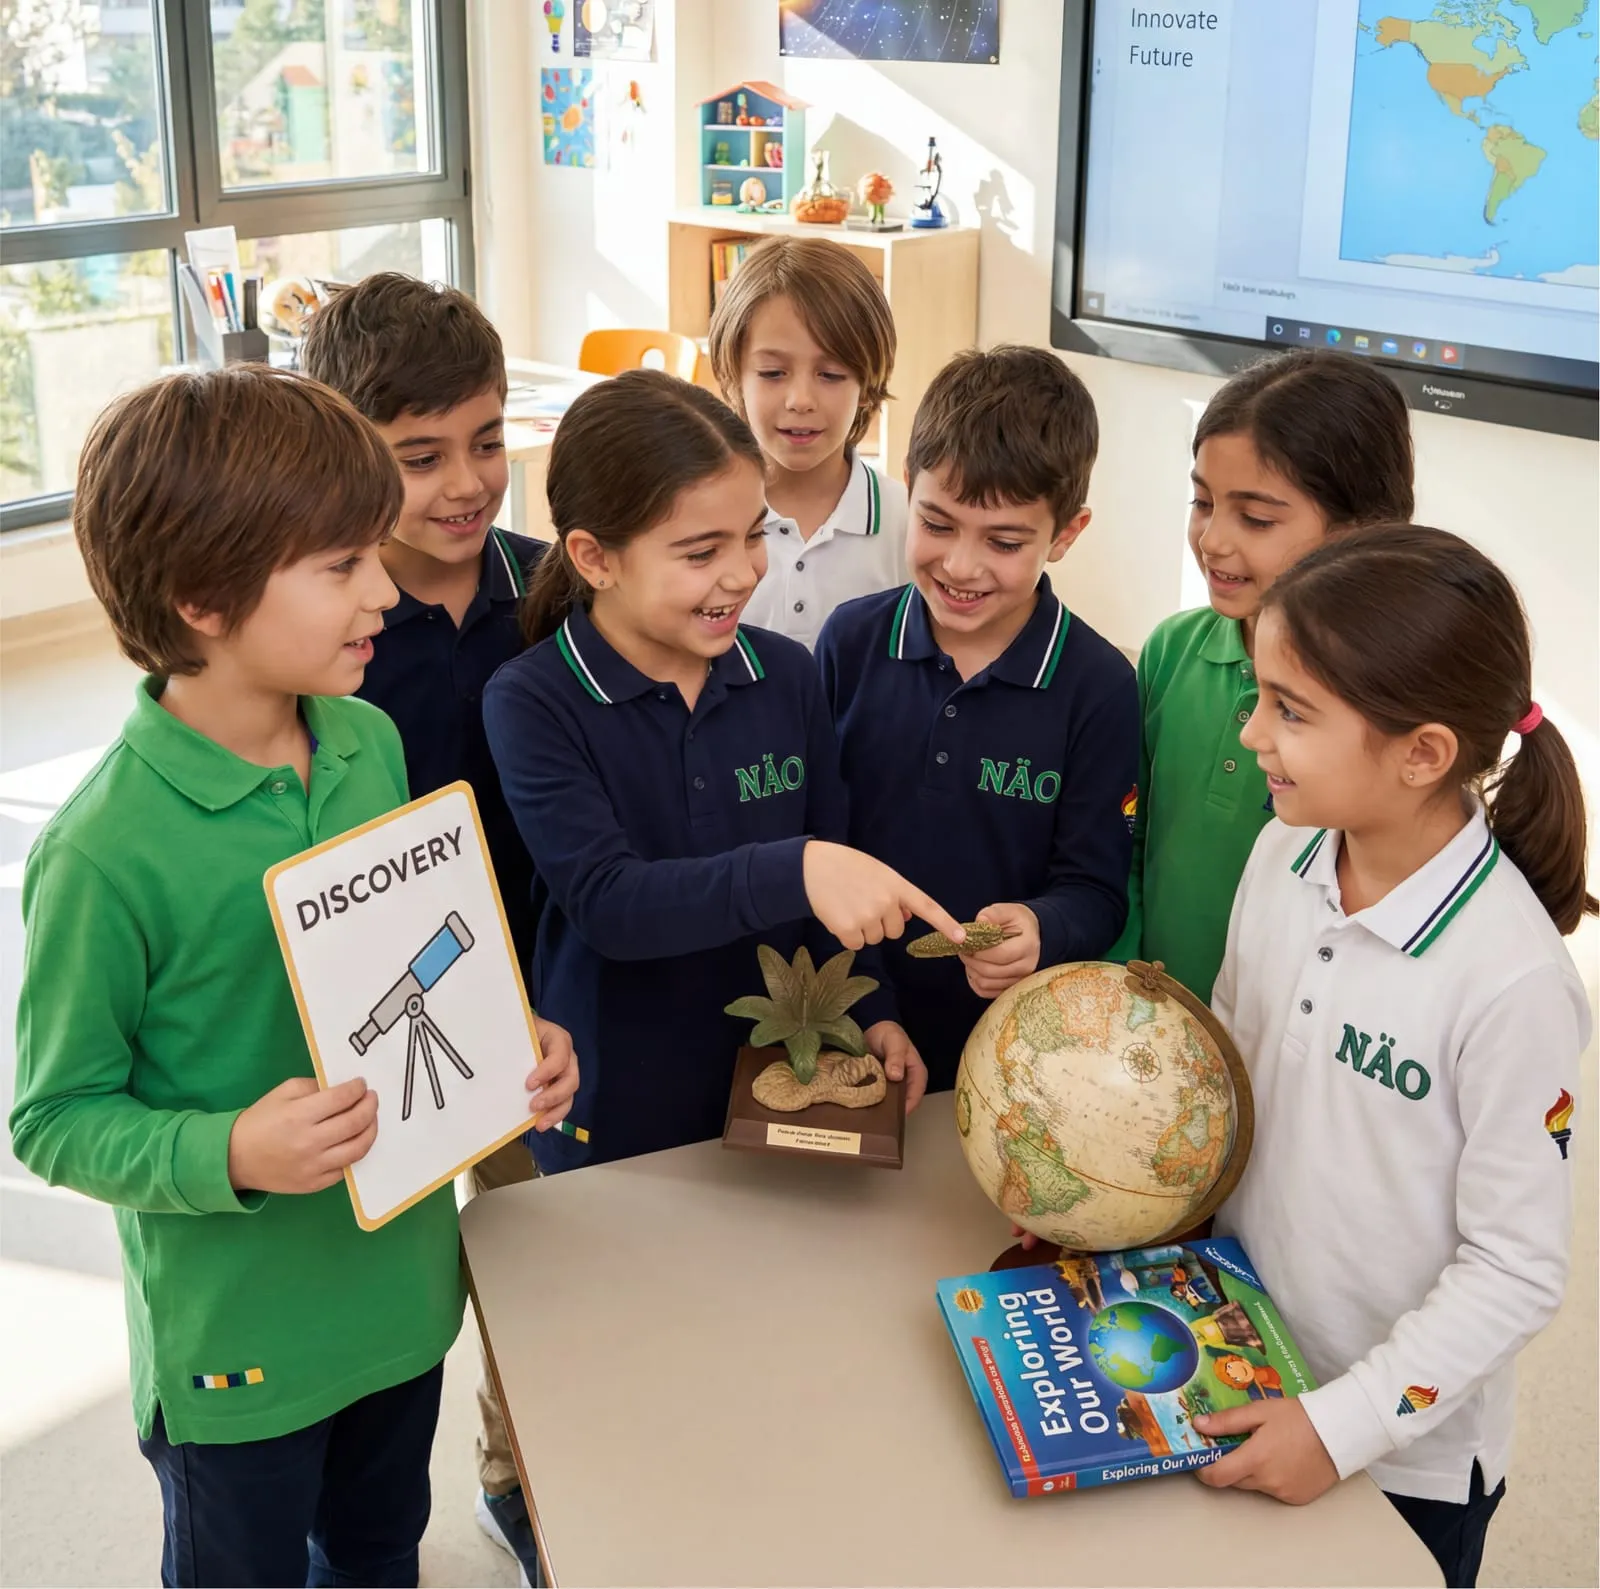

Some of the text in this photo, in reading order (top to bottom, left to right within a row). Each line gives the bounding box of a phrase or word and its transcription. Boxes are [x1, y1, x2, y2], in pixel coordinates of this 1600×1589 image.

[1131, 7, 1218, 30] Innovate
[1130, 45, 1193, 67] Future
[734, 752, 805, 802] NÄO
[977, 757, 1061, 803] NÄO
[296, 825, 462, 931] DISCOVERY
[1335, 1023, 1431, 1101] NÄO
[998, 1292, 1073, 1436] Exploring
[1026, 1287, 1110, 1434] Our World
[1102, 1449, 1222, 1481] Exploring Our World
